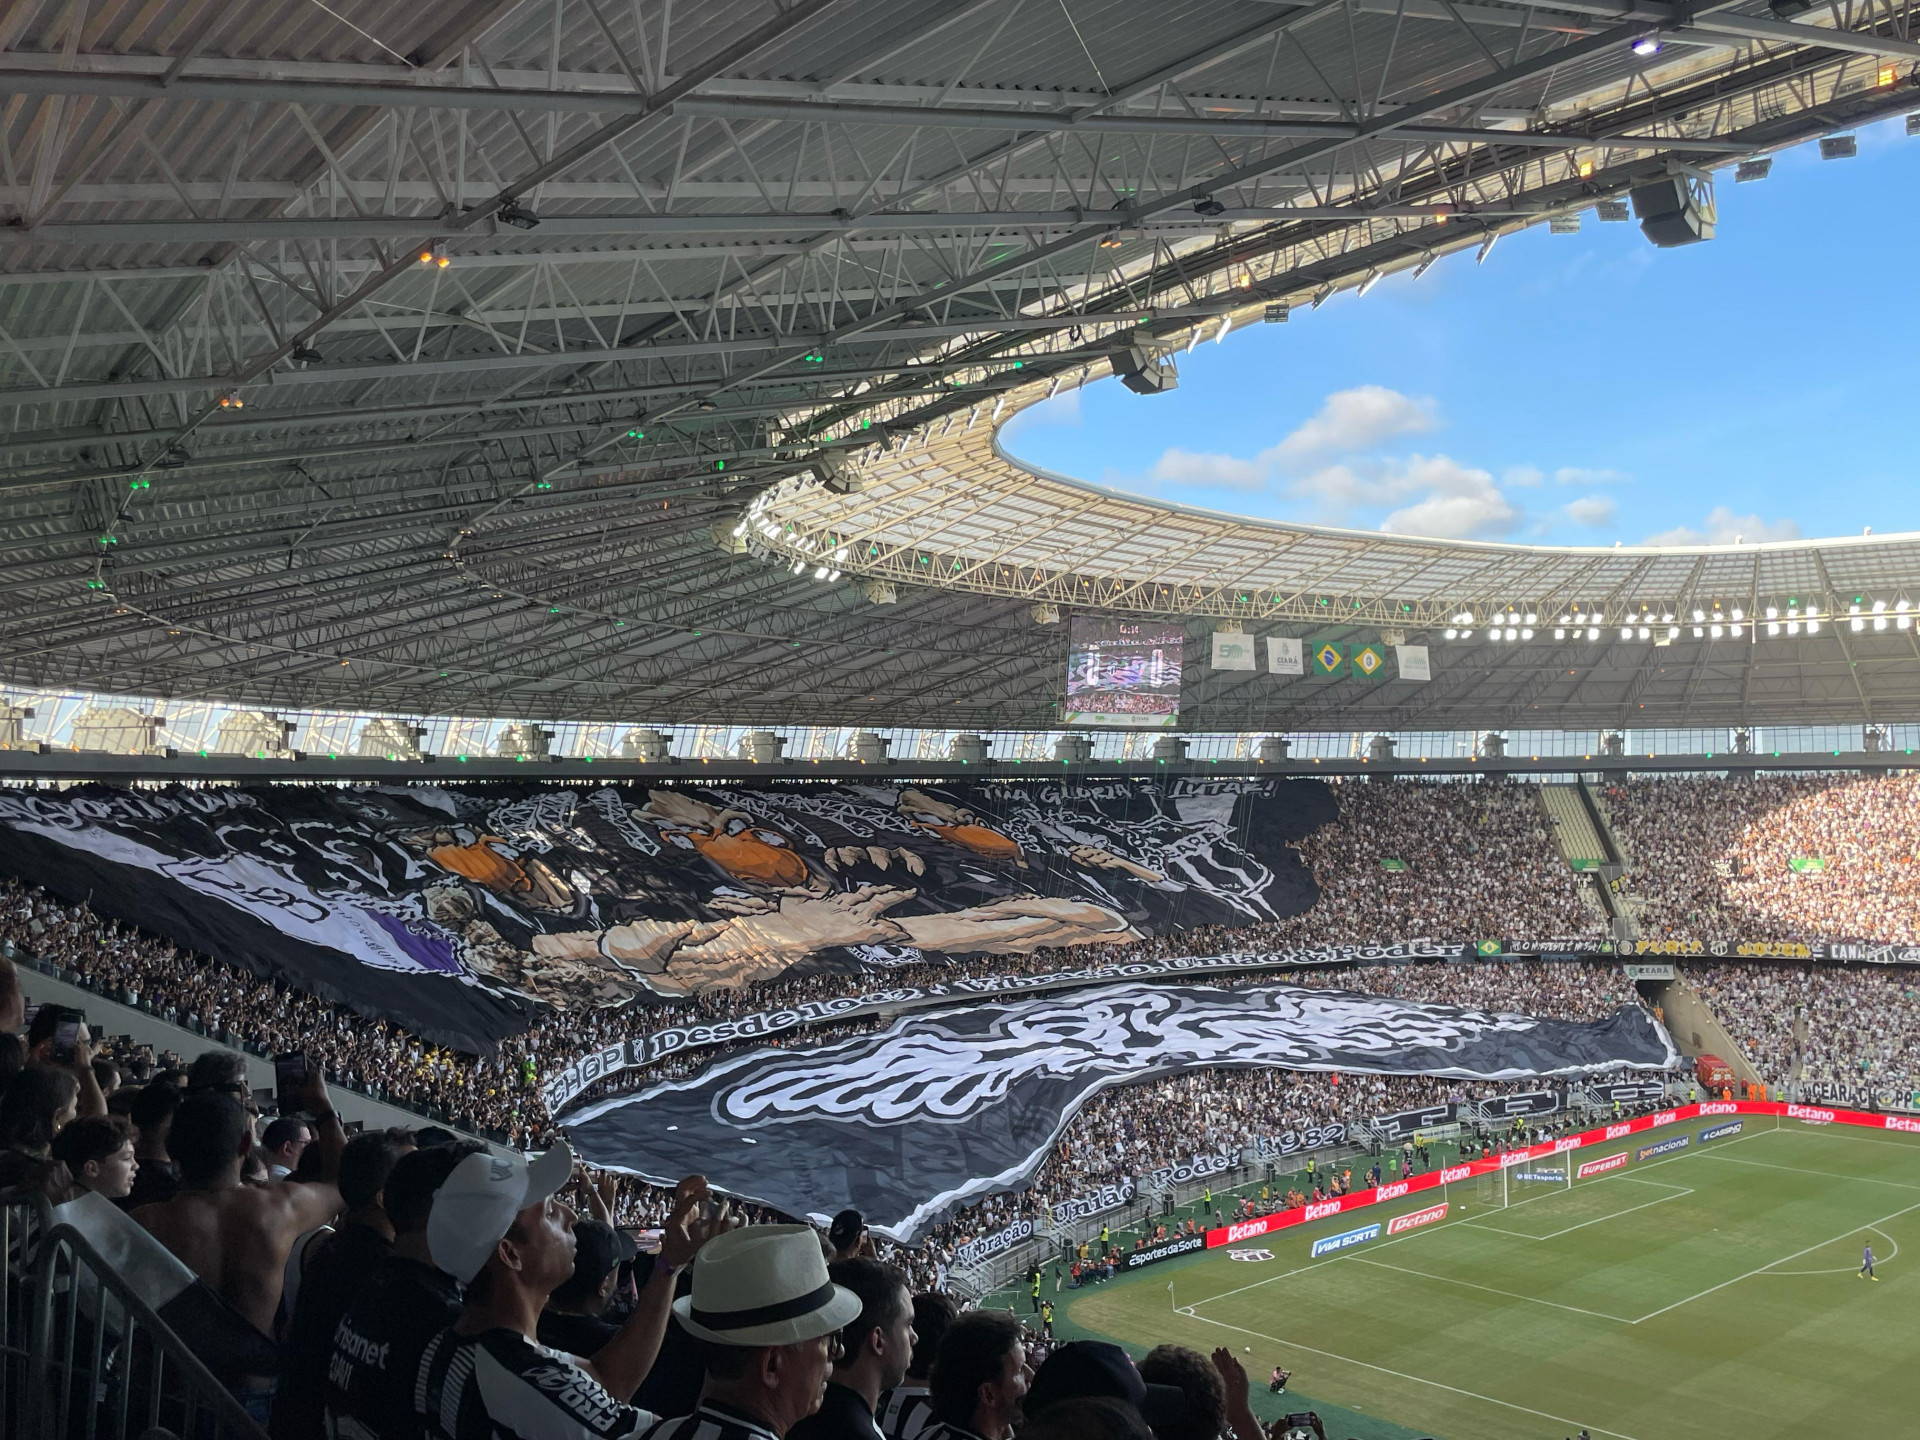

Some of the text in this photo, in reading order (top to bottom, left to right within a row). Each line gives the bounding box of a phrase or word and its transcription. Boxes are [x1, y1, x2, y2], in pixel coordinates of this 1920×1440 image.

[653, 1010, 799, 1059] Desde
[1700, 1102, 1737, 1115] Betano
[1787, 1104, 1835, 1121] Betano
[1654, 1112, 1676, 1127] Betano
[1606, 1123, 1631, 1139] Betano
[1555, 1137, 1582, 1151] Betano
[1639, 1137, 1690, 1161] betnacional
[1582, 1154, 1627, 1175] SUPERBET
[1440, 1166, 1471, 1185] Betano
[1376, 1182, 1409, 1202] Betano
[959, 1220, 1031, 1265] Vibração
[1052, 1183, 1136, 1224] União
[1153, 1153, 1240, 1187] Poder
[1305, 1201, 1341, 1221] Betano
[1395, 1208, 1444, 1231] Betano
[1228, 1220, 1268, 1243] Betano
[1317, 1228, 1378, 1254] VIVA SORTE
[1129, 1237, 1202, 1267] Esportes da Sorte
